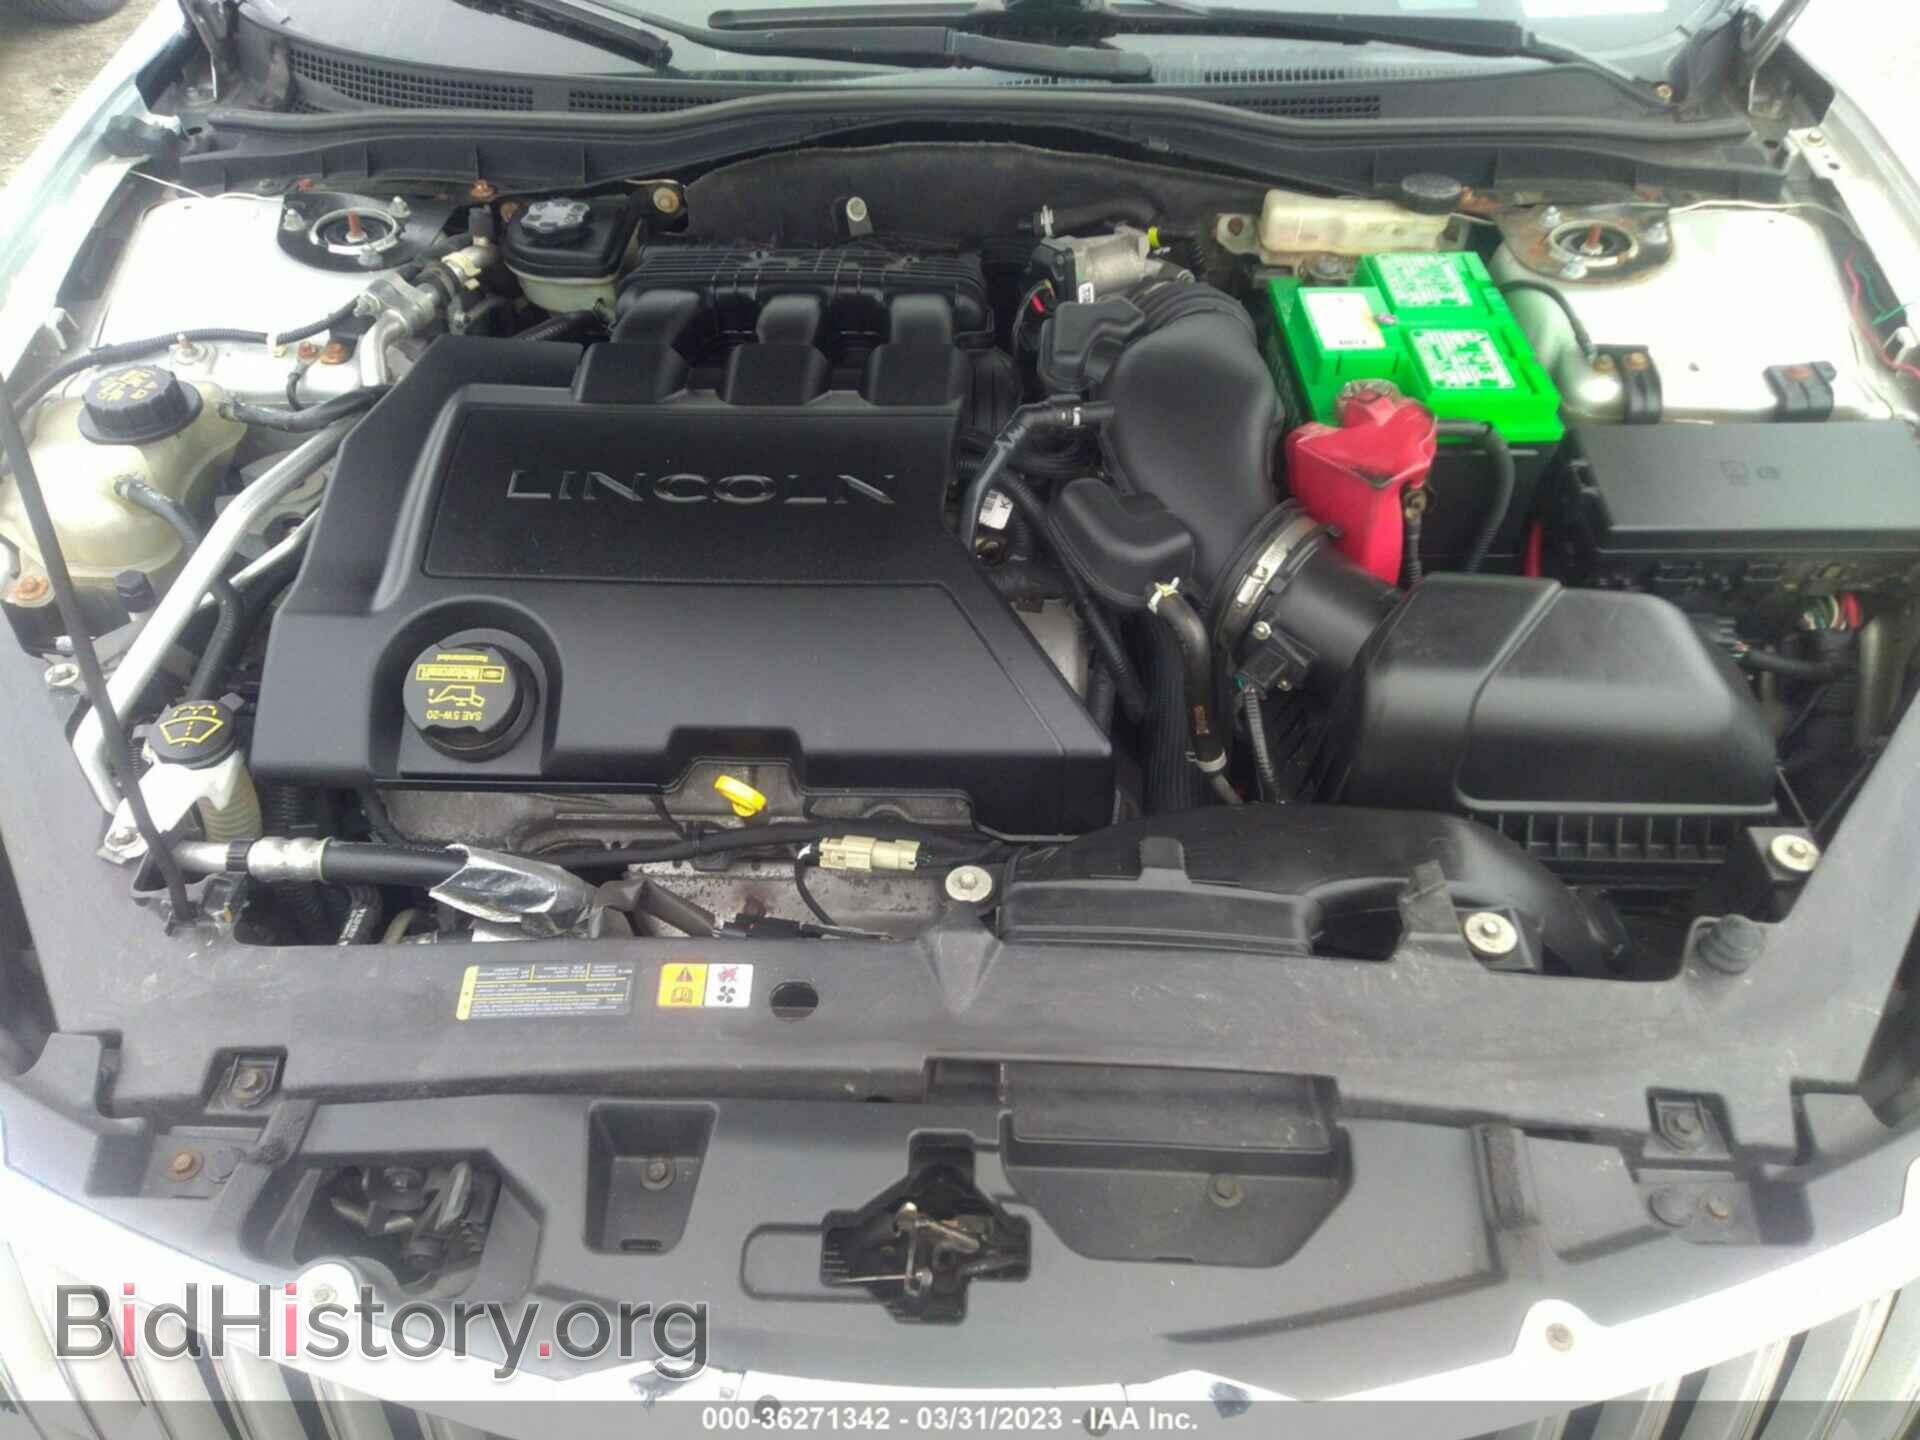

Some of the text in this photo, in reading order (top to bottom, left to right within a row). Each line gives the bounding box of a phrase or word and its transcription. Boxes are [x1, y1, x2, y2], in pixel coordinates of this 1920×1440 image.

[506, 470, 895, 503] LINCOLN
[426, 710, 482, 721] SAE 5W-20
